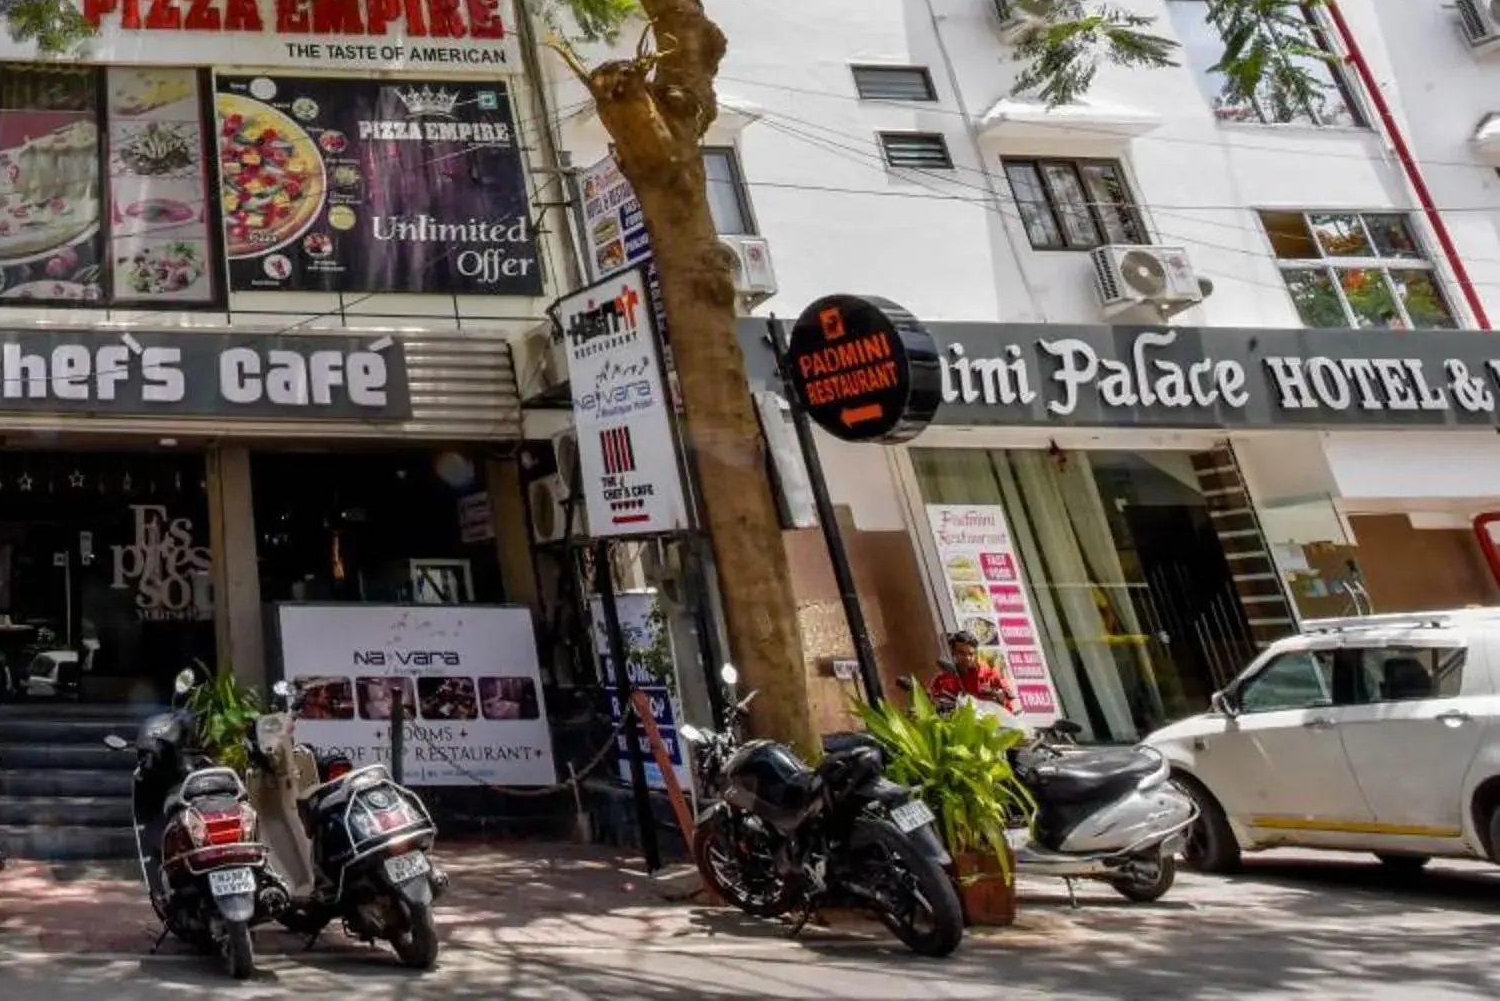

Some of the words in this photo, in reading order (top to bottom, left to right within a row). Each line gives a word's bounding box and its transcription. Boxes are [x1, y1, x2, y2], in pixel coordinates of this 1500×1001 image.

[287, 43, 321, 59] THE
[325, 44, 379, 60] TASTE
[383, 45, 405, 61] OF
[410, 47, 507, 65] AMERICAN
[358, 120, 423, 140] PIZZA
[425, 122, 511, 141] EMPIRE
[372, 214, 529, 244] Unlimited
[457, 248, 534, 284] Offer
[800, 331, 891, 379] PADMINI
[806, 360, 898, 406] RESTAURANT
[1037, 330, 1250, 417] Palace
[1263, 356, 1449, 412] HOTEL
[1447, 358, 1496, 412] &
[415, 745, 534, 764] RESTAURANT
